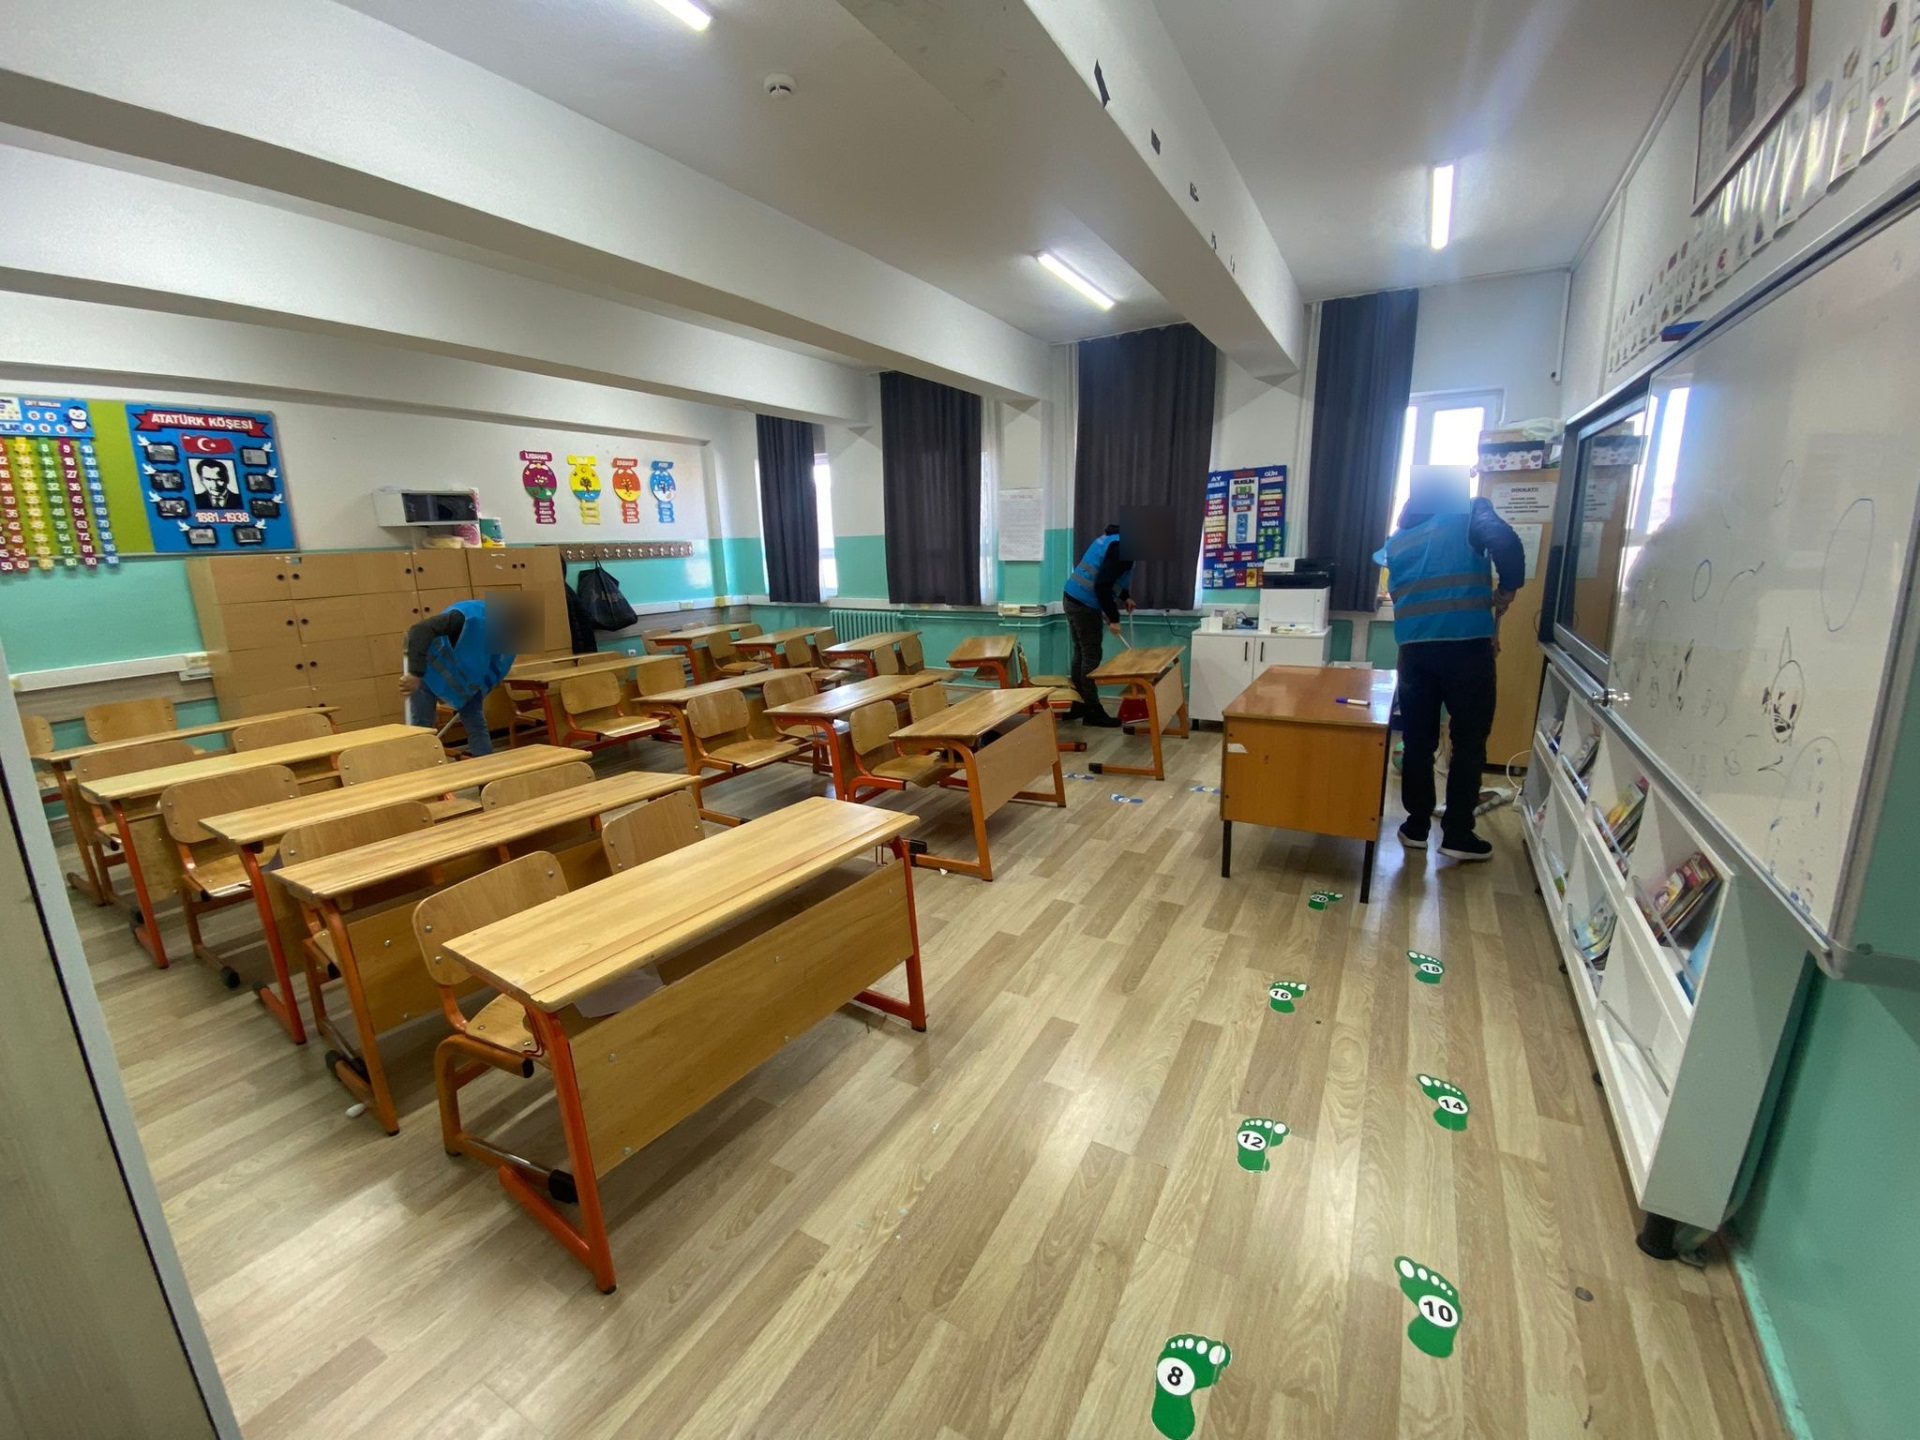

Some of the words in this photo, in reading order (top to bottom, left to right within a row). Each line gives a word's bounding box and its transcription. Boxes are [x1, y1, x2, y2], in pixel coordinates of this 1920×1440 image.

[152, 413, 205, 426] ATATÜRK
[208, 417, 253, 429] KÖŞESİ
[41, 443, 49, 452] 8
[63, 445, 71, 453] 9
[82, 445, 93, 453] 10
[63, 457, 75, 466] 18
[84, 457, 96, 466] 20
[66, 470, 78, 478] 27
[87, 470, 99, 478] 30
[47, 483, 60, 491] 32
[68, 483, 81, 491] 36
[90, 482, 102, 490] 40
[3, 496, 16, 505] 30
[71, 495, 83, 504] 45
[93, 494, 105, 503] 50
[5, 509, 19, 518] 36
[52, 508, 65, 516] 48
[73, 508, 85, 516] 54
[76, 520, 88, 529] 63
[98, 519, 110, 528] 70
[79, 532, 91, 541] 72
[14, 548, 26, 557] 54
[62, 546, 74, 554] 72
[82, 545, 93, 553] 81
[103, 544, 116, 552] 90
[17, 560, 30, 569] 60
[85, 557, 97, 565] 90
[1, 562, 13, 571] 50
[1423, 965, 1440, 973] 18
[1273, 990, 1289, 999] 16
[1441, 1099, 1464, 1111] 14
[1242, 1133, 1263, 1149] 12
[1423, 1300, 1453, 1322] 10
[1167, 1366, 1183, 1386] 8
